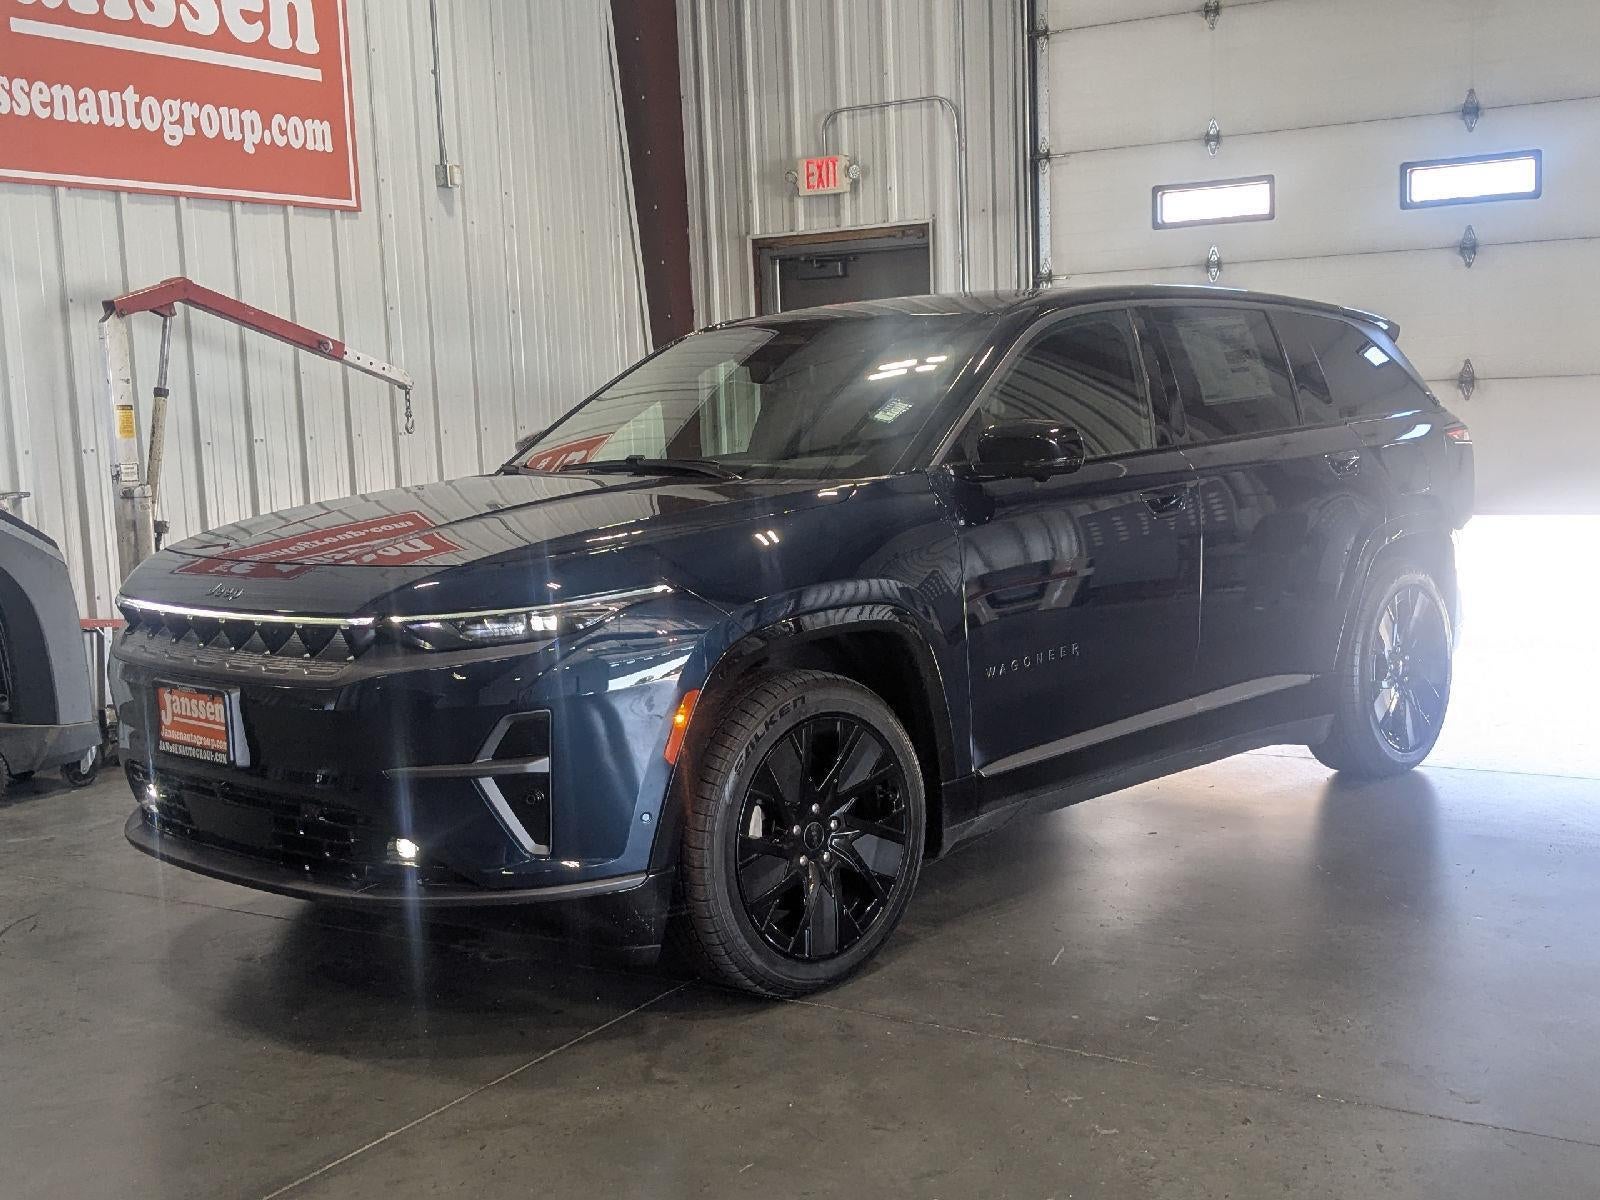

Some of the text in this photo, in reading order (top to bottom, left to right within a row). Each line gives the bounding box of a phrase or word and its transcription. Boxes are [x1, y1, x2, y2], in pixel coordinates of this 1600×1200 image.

[806, 158, 838, 190] EXIT
[985, 643, 1080, 678] WAGONEER
[161, 690, 225, 725] Janssen
